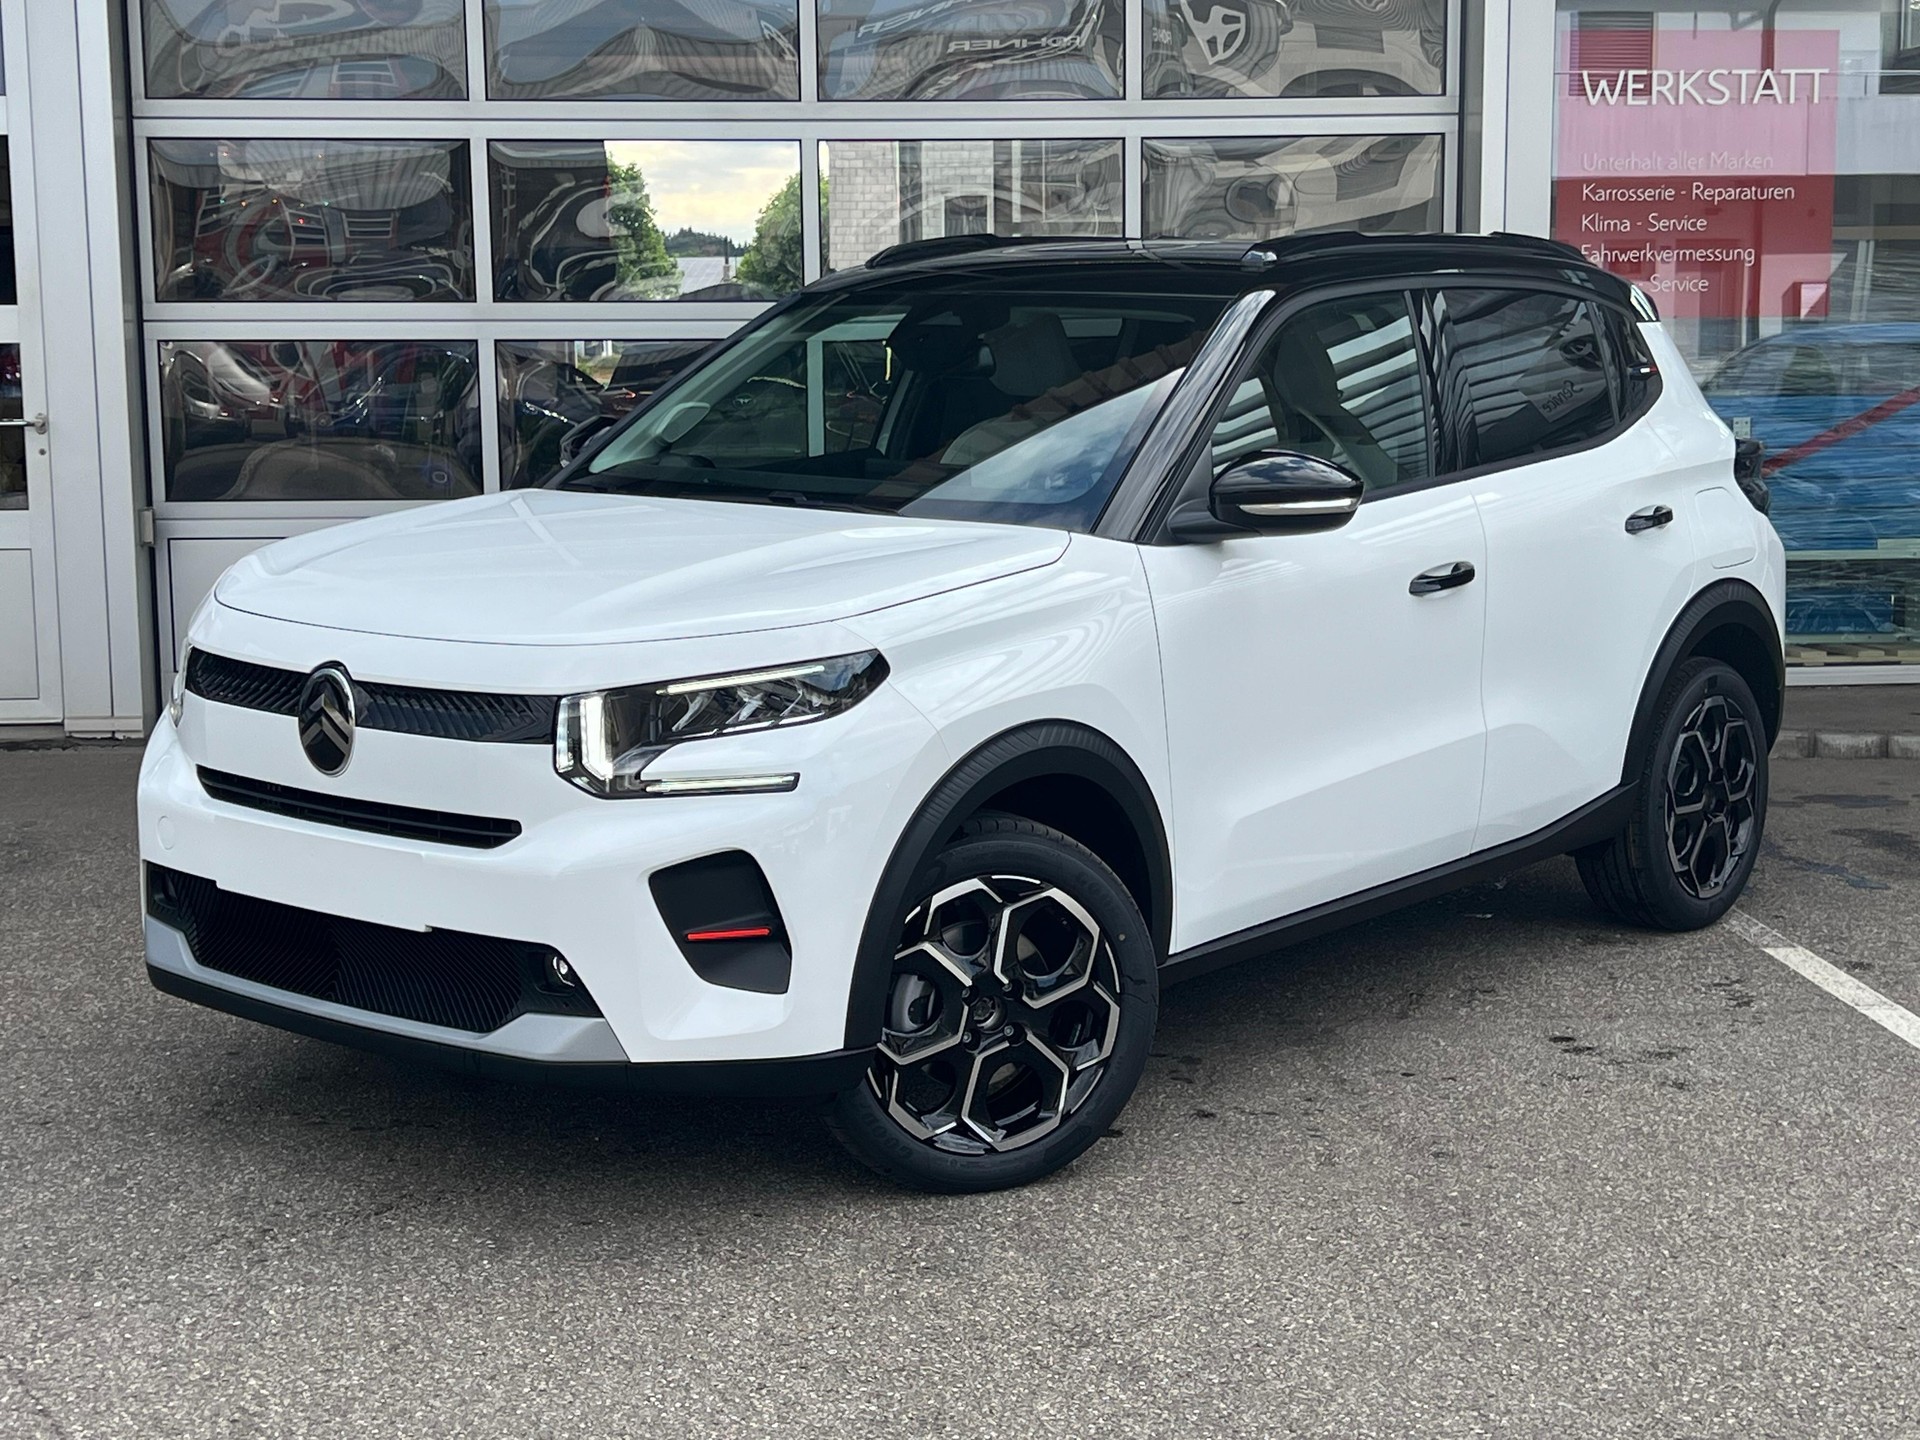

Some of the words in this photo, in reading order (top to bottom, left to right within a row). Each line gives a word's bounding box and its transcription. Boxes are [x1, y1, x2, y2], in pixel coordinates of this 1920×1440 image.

[1582, 68, 1831, 106] WERKSTATT
[1583, 152, 1662, 172] Unterhalt
[1667, 152, 1704, 170] aller
[1709, 151, 1774, 170] Marken
[1582, 183, 1676, 202] Karrosserie
[1691, 182, 1796, 205] Reparaturen
[1581, 213, 1631, 232] Klima
[1647, 212, 1708, 232] Service
[1580, 243, 1756, 266] Fahrwerkvermessung
[1649, 273, 1709, 293] Service
